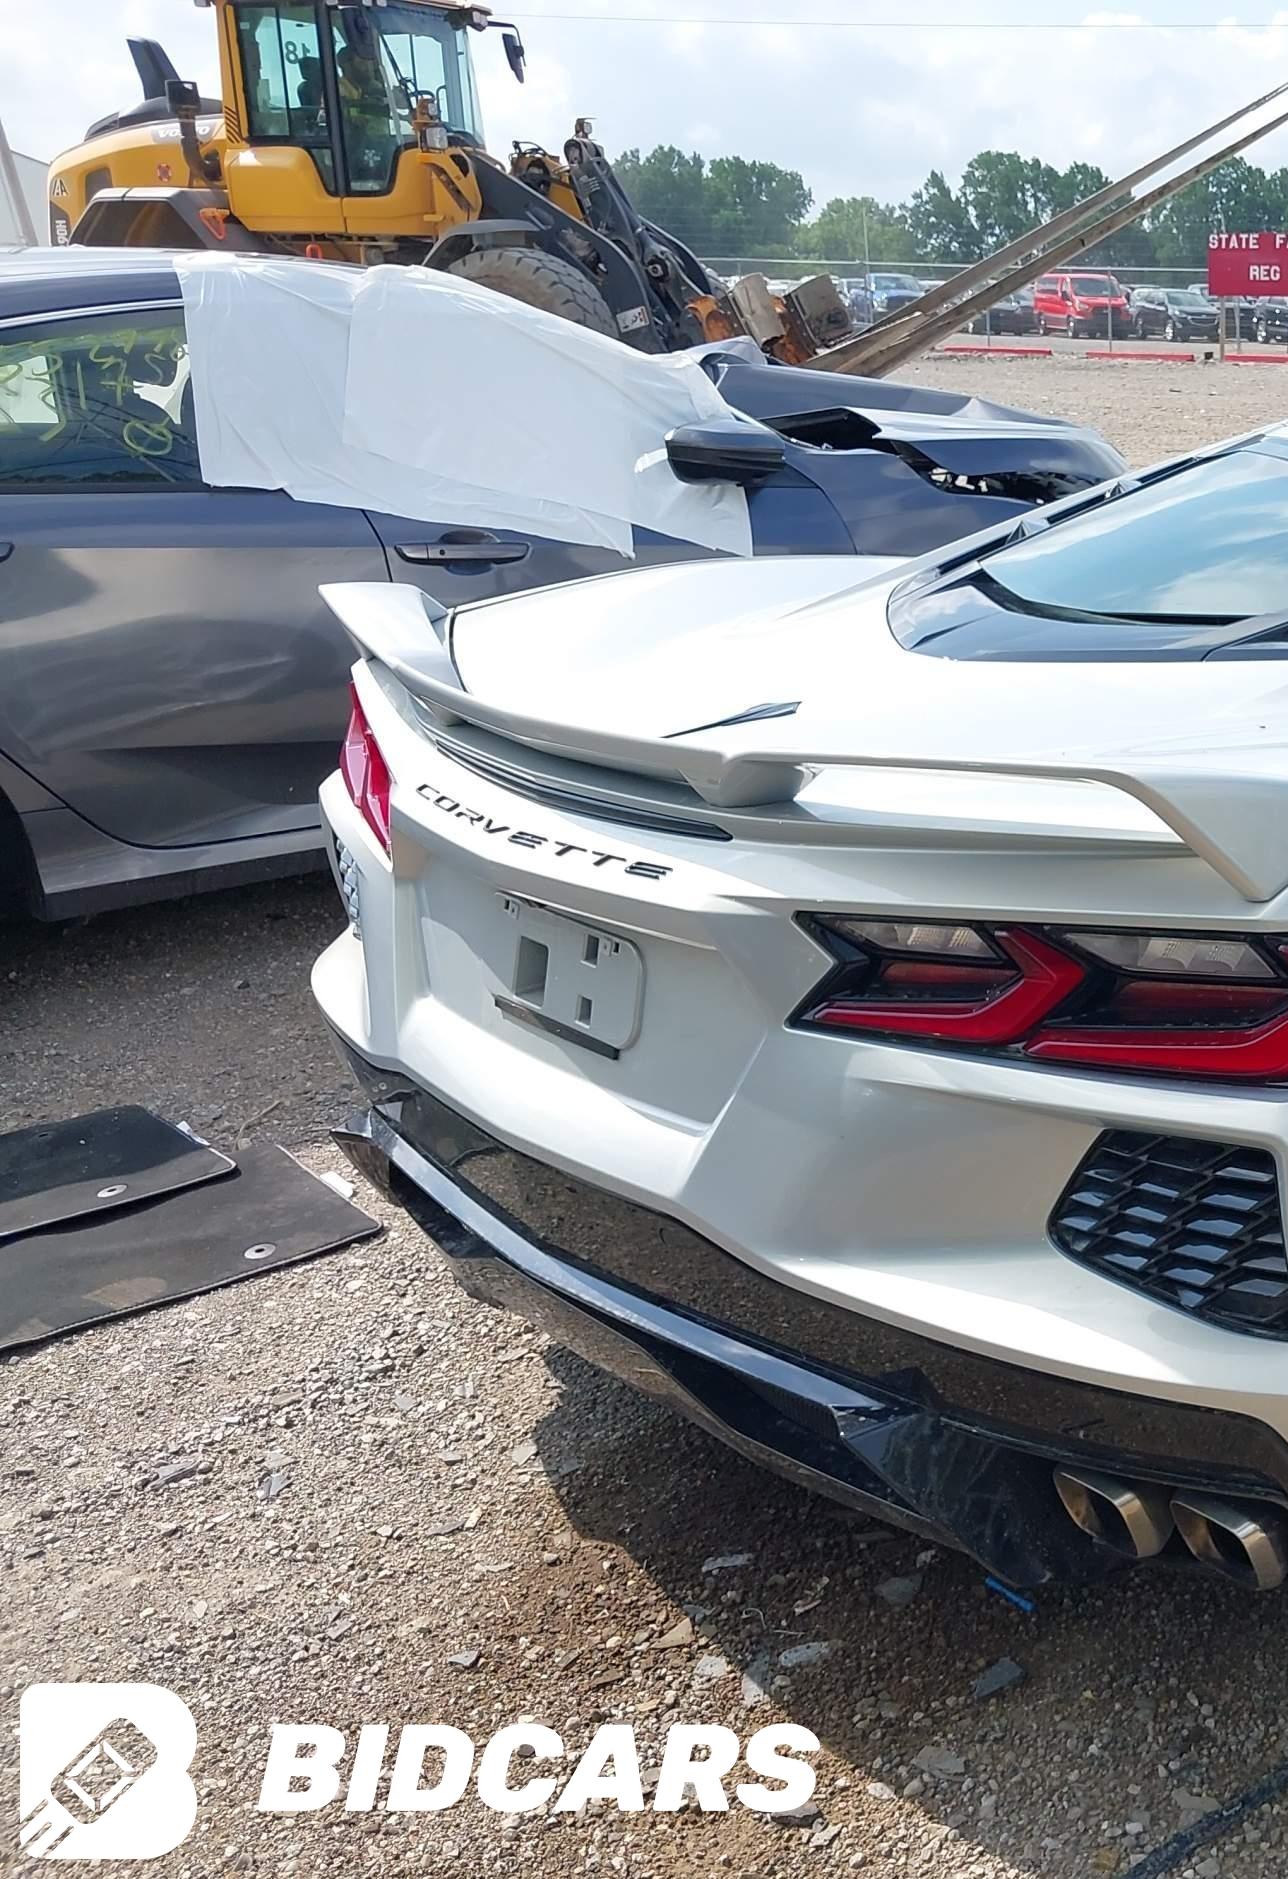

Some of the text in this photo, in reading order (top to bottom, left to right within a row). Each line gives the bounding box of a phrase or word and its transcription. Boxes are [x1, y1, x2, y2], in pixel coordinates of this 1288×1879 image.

[158, 125, 211, 139] VOO
[1208, 233, 1259, 249] STATE
[1249, 265, 1281, 281] REG
[415, 783, 674, 881] CORVETTE
